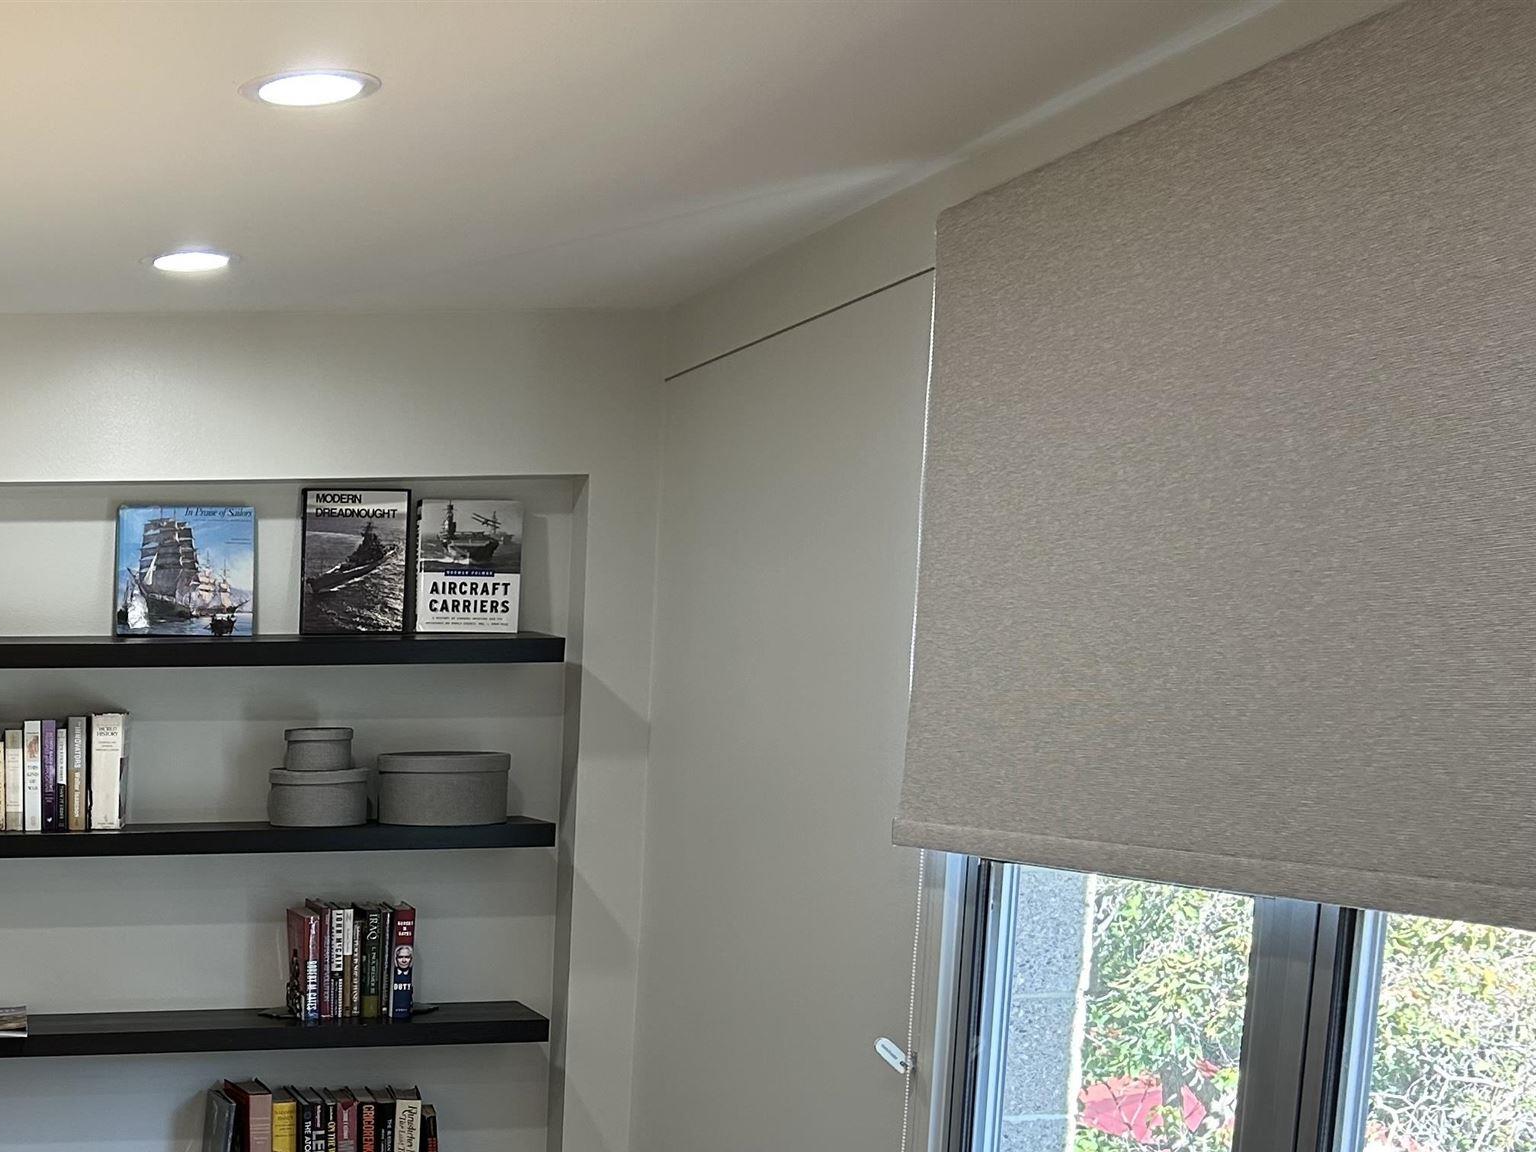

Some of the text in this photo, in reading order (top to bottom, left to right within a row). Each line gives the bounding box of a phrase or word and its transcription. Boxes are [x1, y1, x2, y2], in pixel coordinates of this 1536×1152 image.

[315, 493, 362, 504] MODERN
[218, 506, 228, 519] of
[228, 508, 252, 518] Sailors
[315, 507, 398, 519] DREADNOUGHT
[429, 581, 511, 596] AIRCRAFT
[428, 599, 510, 614] CARRIERS
[367, 913, 378, 941] IRAQ
[393, 983, 412, 991] DUTY
[304, 1120, 312, 1134] THE
